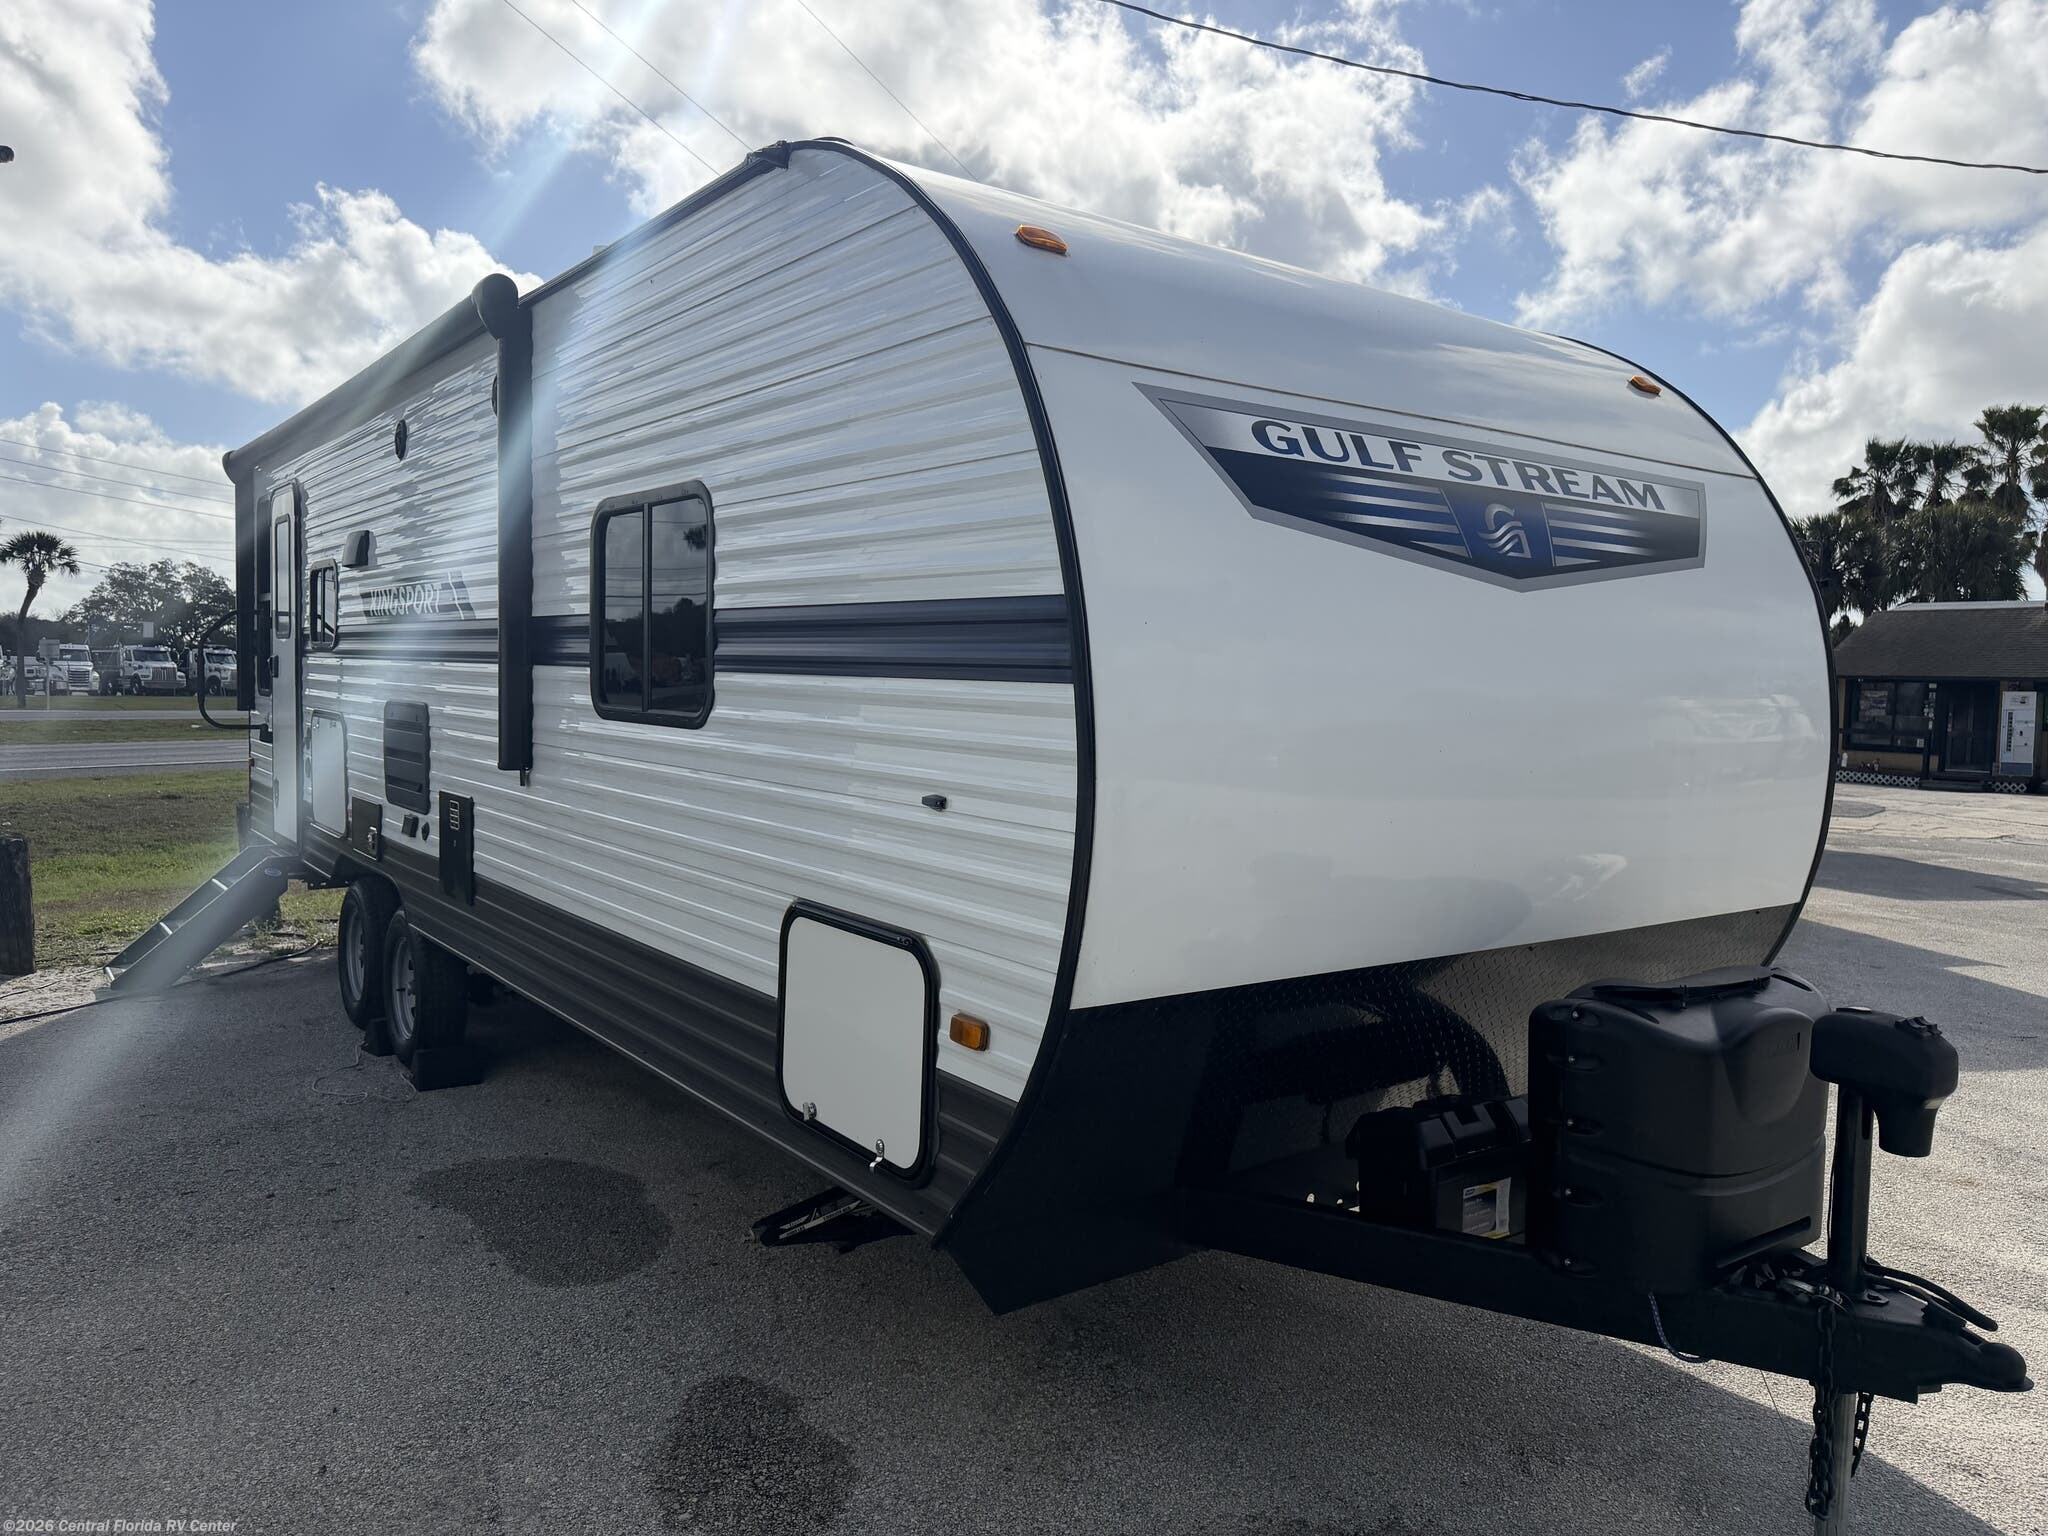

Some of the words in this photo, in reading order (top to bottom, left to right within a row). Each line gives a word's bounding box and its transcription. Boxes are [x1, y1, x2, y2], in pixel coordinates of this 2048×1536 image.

[1251, 419, 1423, 473] GULF
[1441, 449, 1666, 511] STREAM
[369, 583, 442, 616] KINGSPORT
